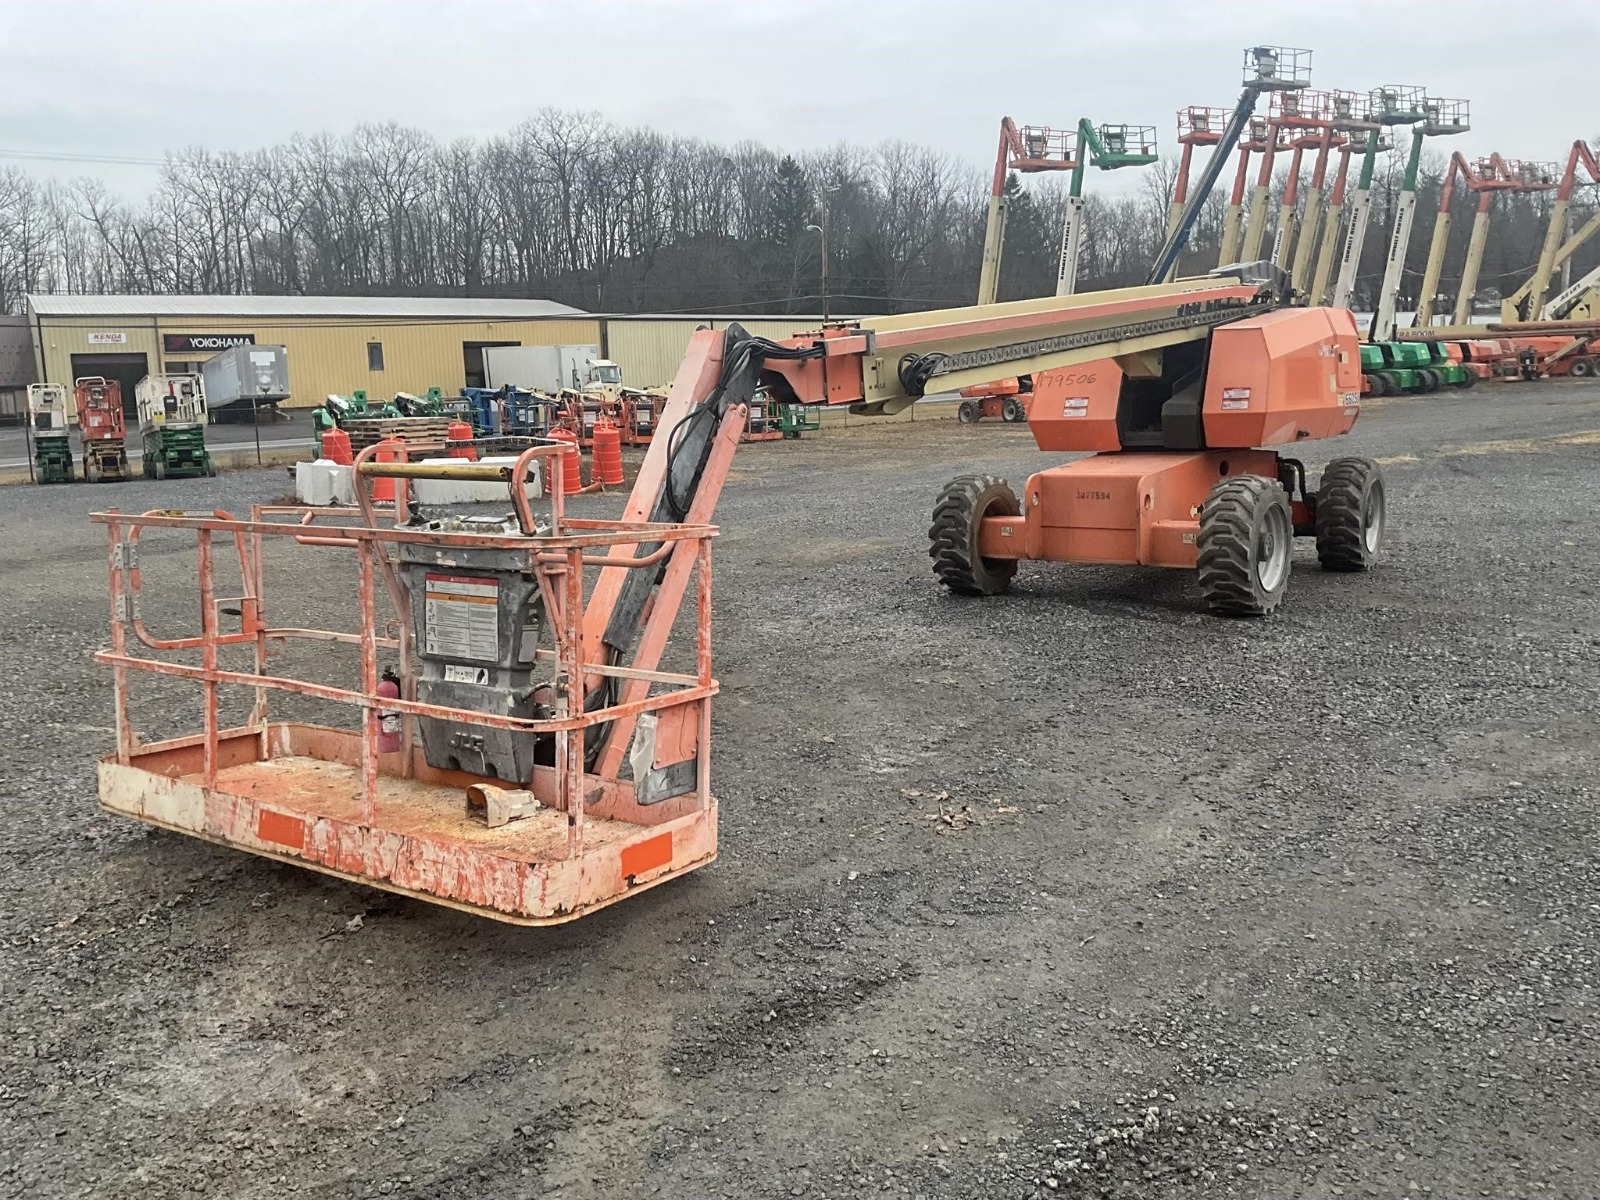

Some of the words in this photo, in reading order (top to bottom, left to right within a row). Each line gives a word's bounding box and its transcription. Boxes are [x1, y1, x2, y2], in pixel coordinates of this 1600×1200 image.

[1395, 208, 1405, 235] RENTALS
[1344, 236, 1353, 263] SUNBELT
[1350, 208, 1359, 235] RENTALS
[189, 337, 251, 348] YOKOHAMA
